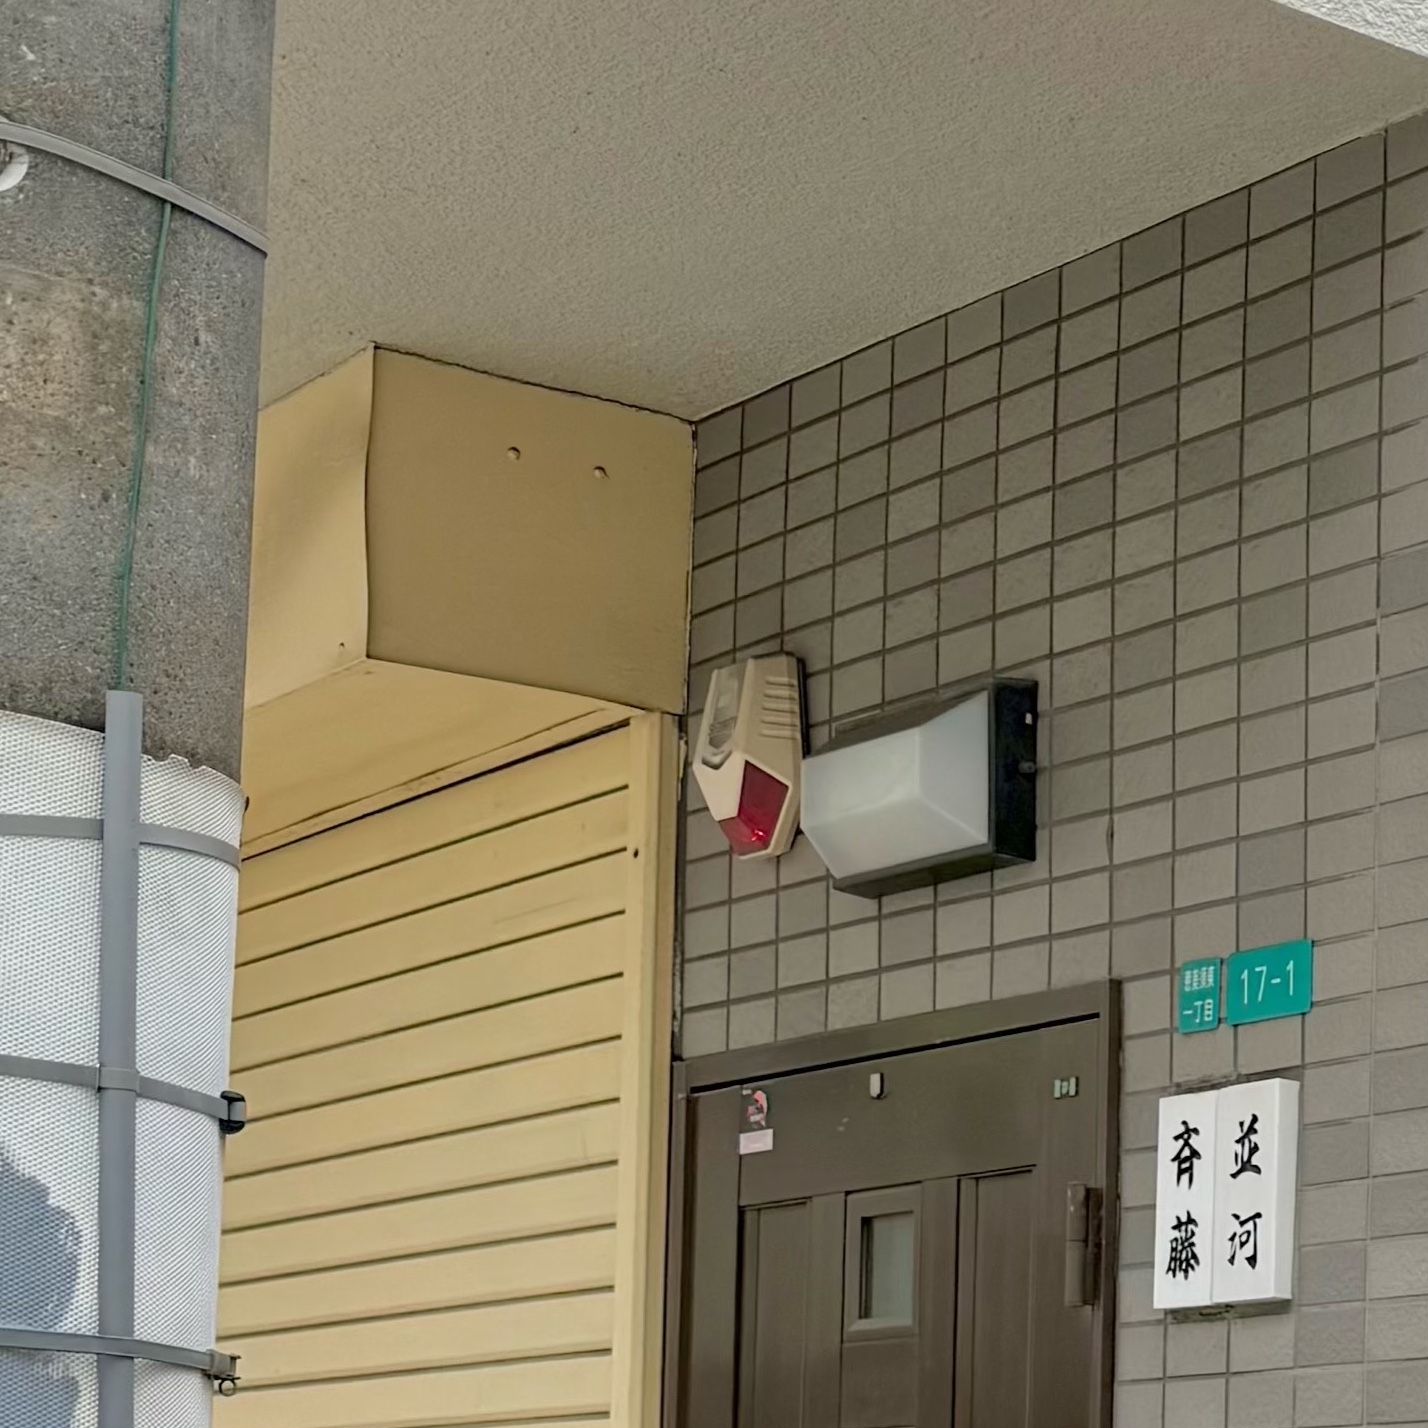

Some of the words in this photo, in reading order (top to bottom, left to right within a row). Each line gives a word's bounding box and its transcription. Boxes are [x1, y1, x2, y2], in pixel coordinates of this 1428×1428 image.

[1241, 960, 1295, 1004] 17-1
[1183, 999, 1214, 1023] 一丁目
